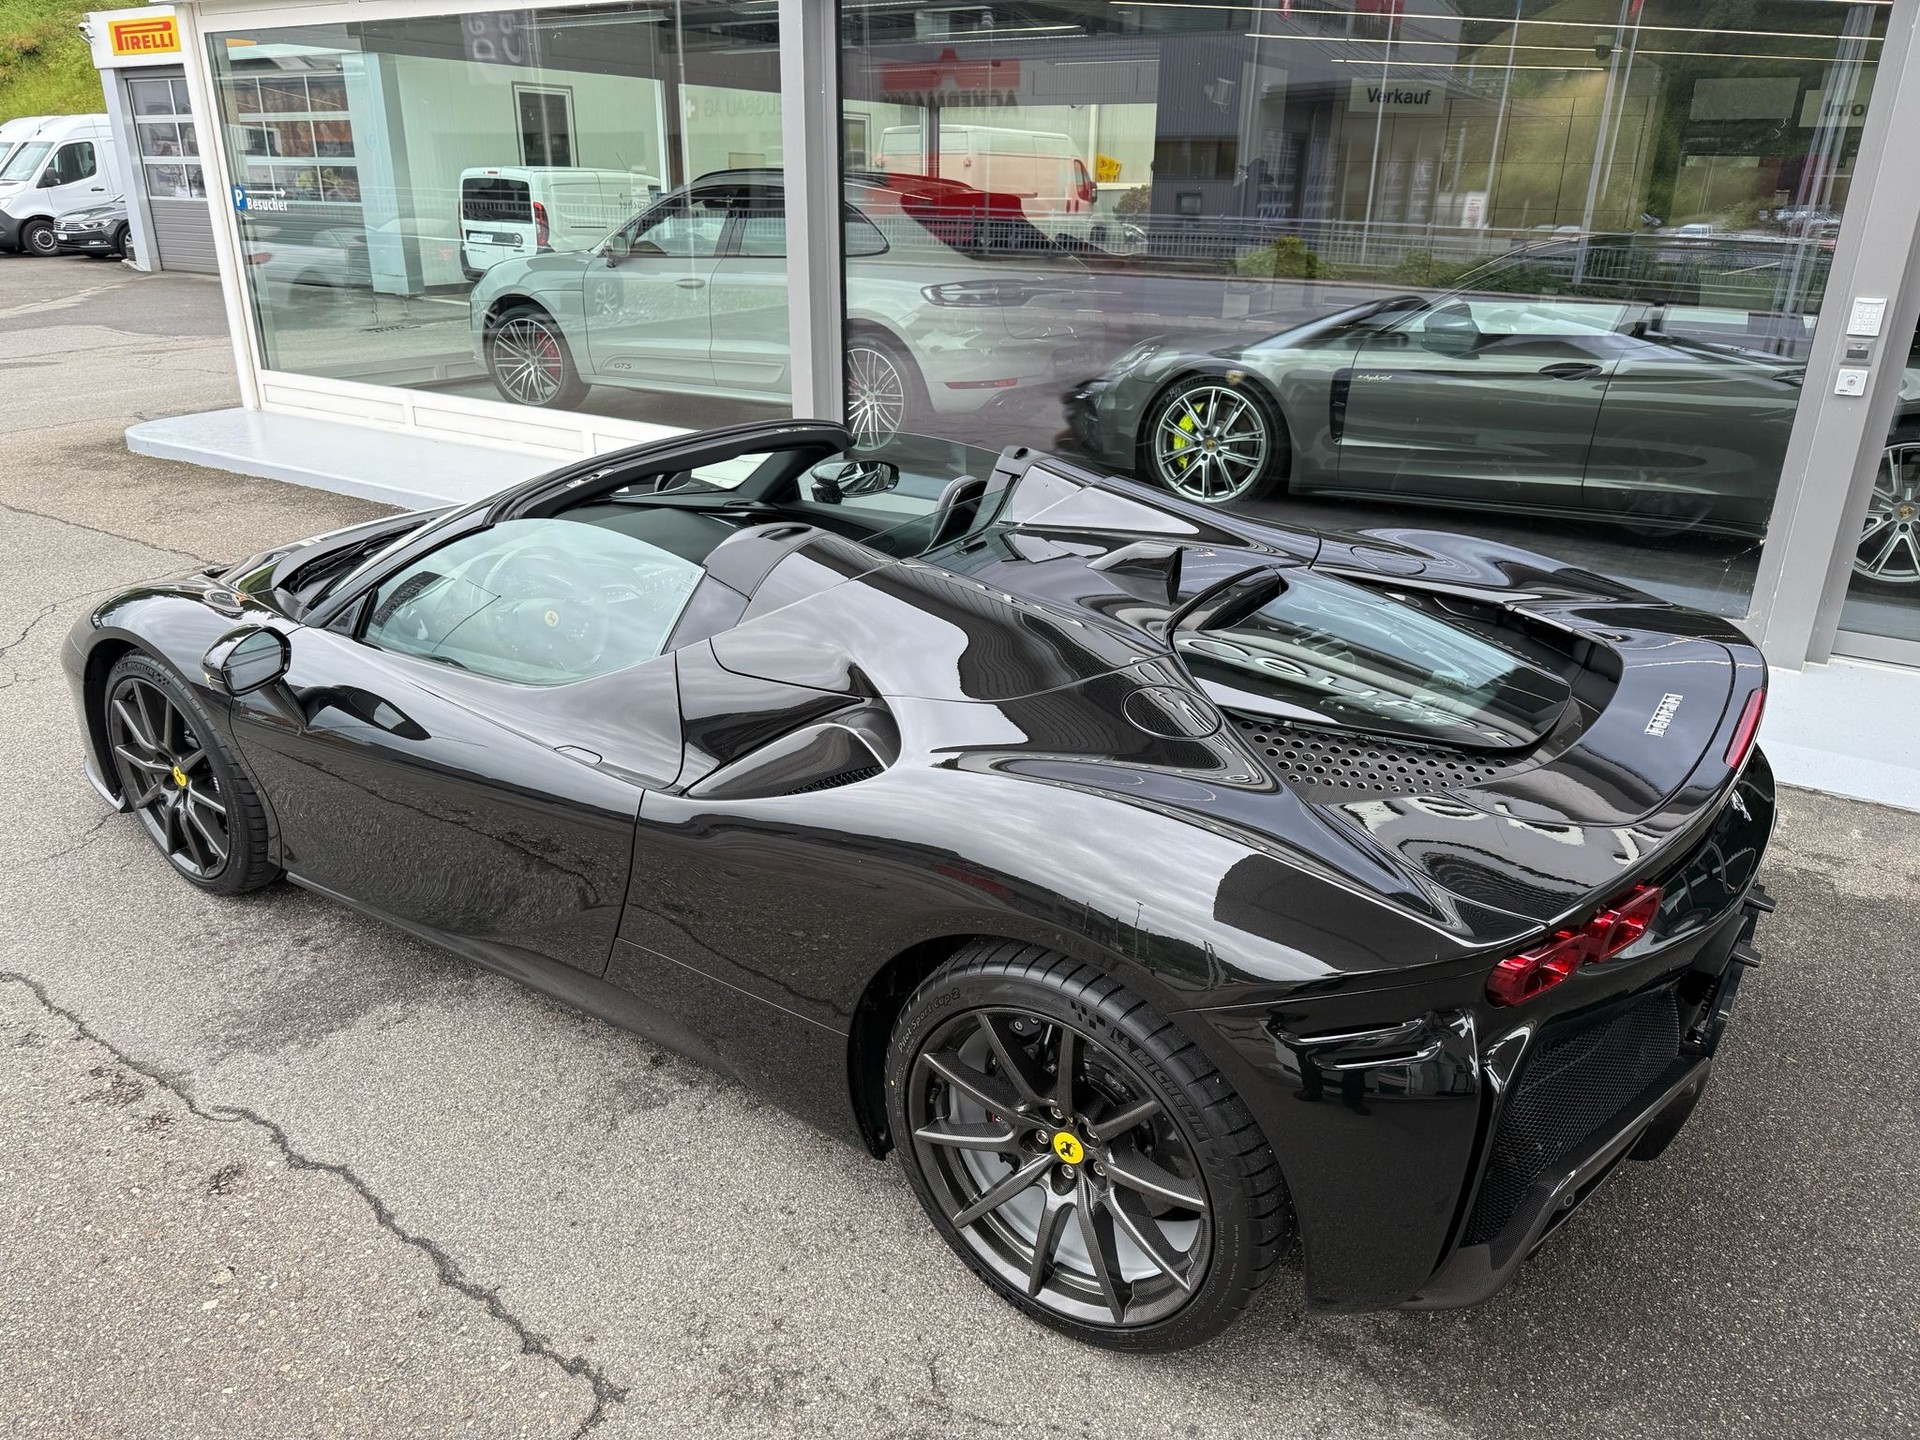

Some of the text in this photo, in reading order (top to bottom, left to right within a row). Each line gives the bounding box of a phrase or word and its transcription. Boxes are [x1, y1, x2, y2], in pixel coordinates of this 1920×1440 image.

[114, 21, 174, 51] PIRELLI
[1367, 88, 1432, 105] Verkauf
[235, 189, 288, 211] P Besucher
[898, 987, 961, 1053] Pilot Sport Cup 2
[1131, 1048, 1213, 1144] MICHELIN
